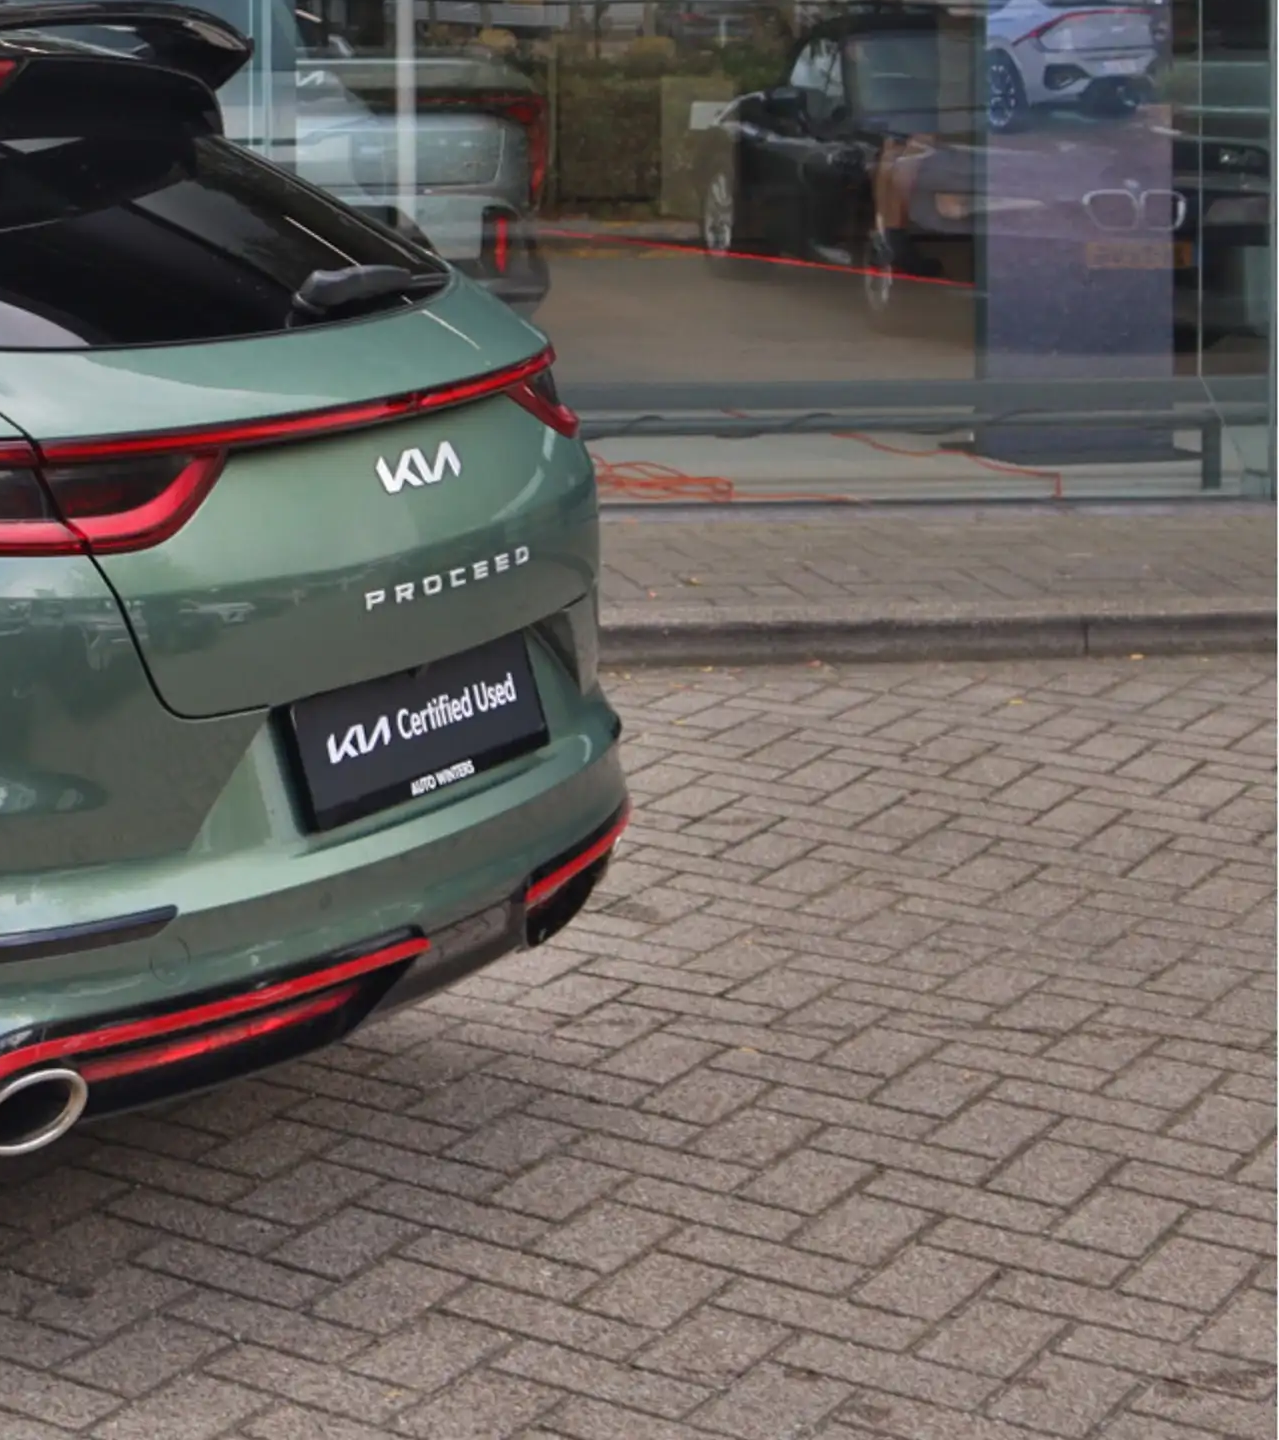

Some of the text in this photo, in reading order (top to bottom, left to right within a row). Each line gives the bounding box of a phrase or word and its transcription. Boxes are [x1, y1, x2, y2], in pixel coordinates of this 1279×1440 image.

[375, 440, 462, 494] KIA
[364, 546, 530, 611] PROCEED
[326, 671, 518, 765] KIA Certified Used
[410, 759, 476, 797] AUTO WINTERS
